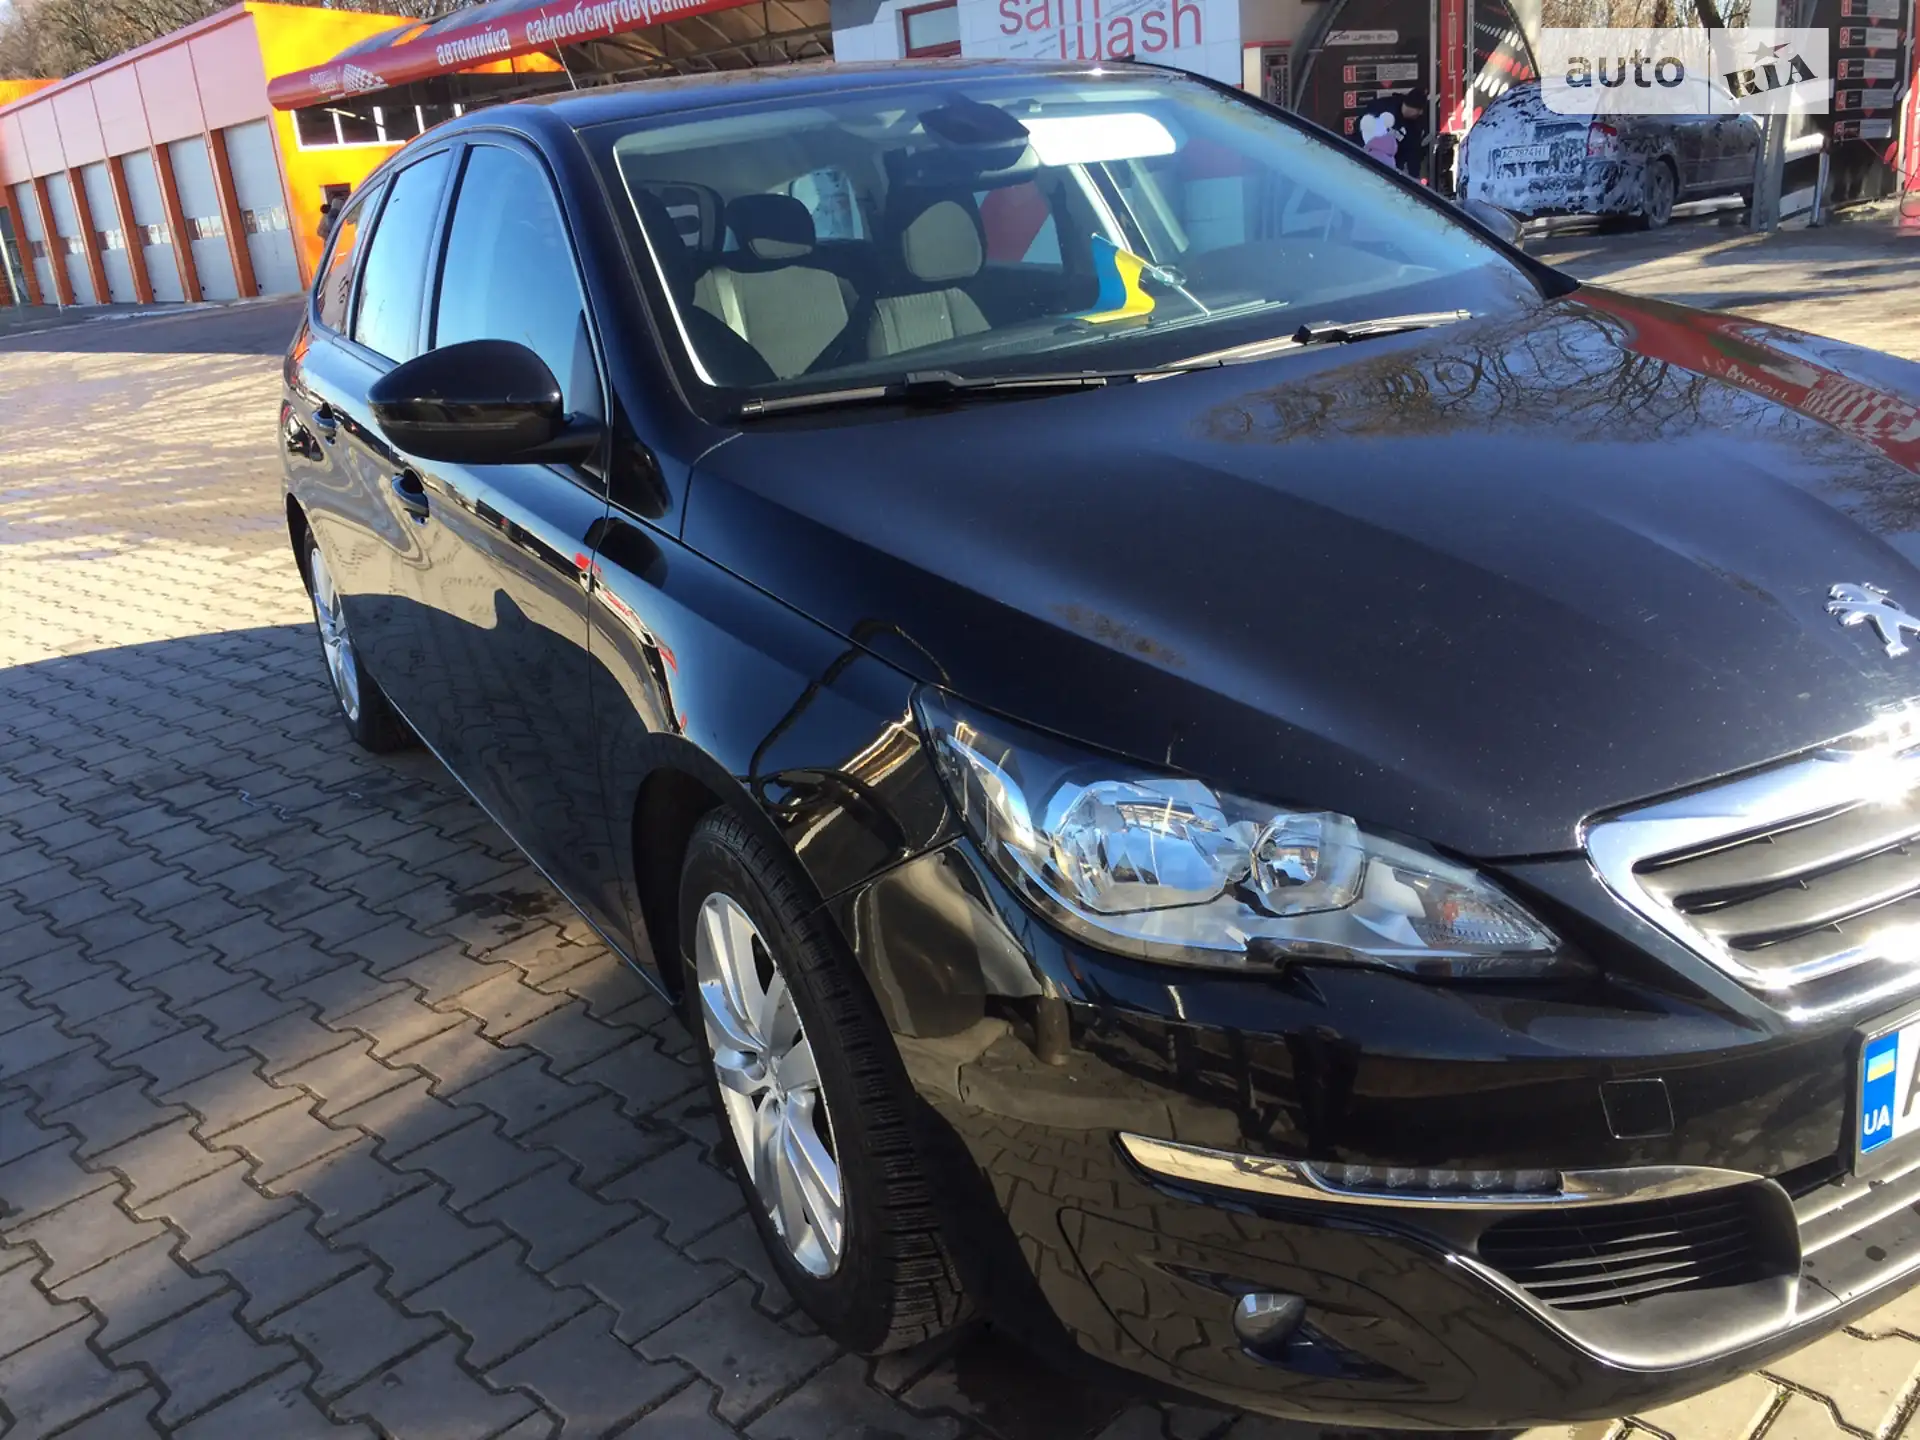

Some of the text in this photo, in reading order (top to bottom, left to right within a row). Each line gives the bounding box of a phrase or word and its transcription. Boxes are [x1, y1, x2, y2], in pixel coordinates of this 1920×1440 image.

[436, 0, 706, 66] автомийка самообслуговува
[1863, 1104, 1890, 1136] UA
